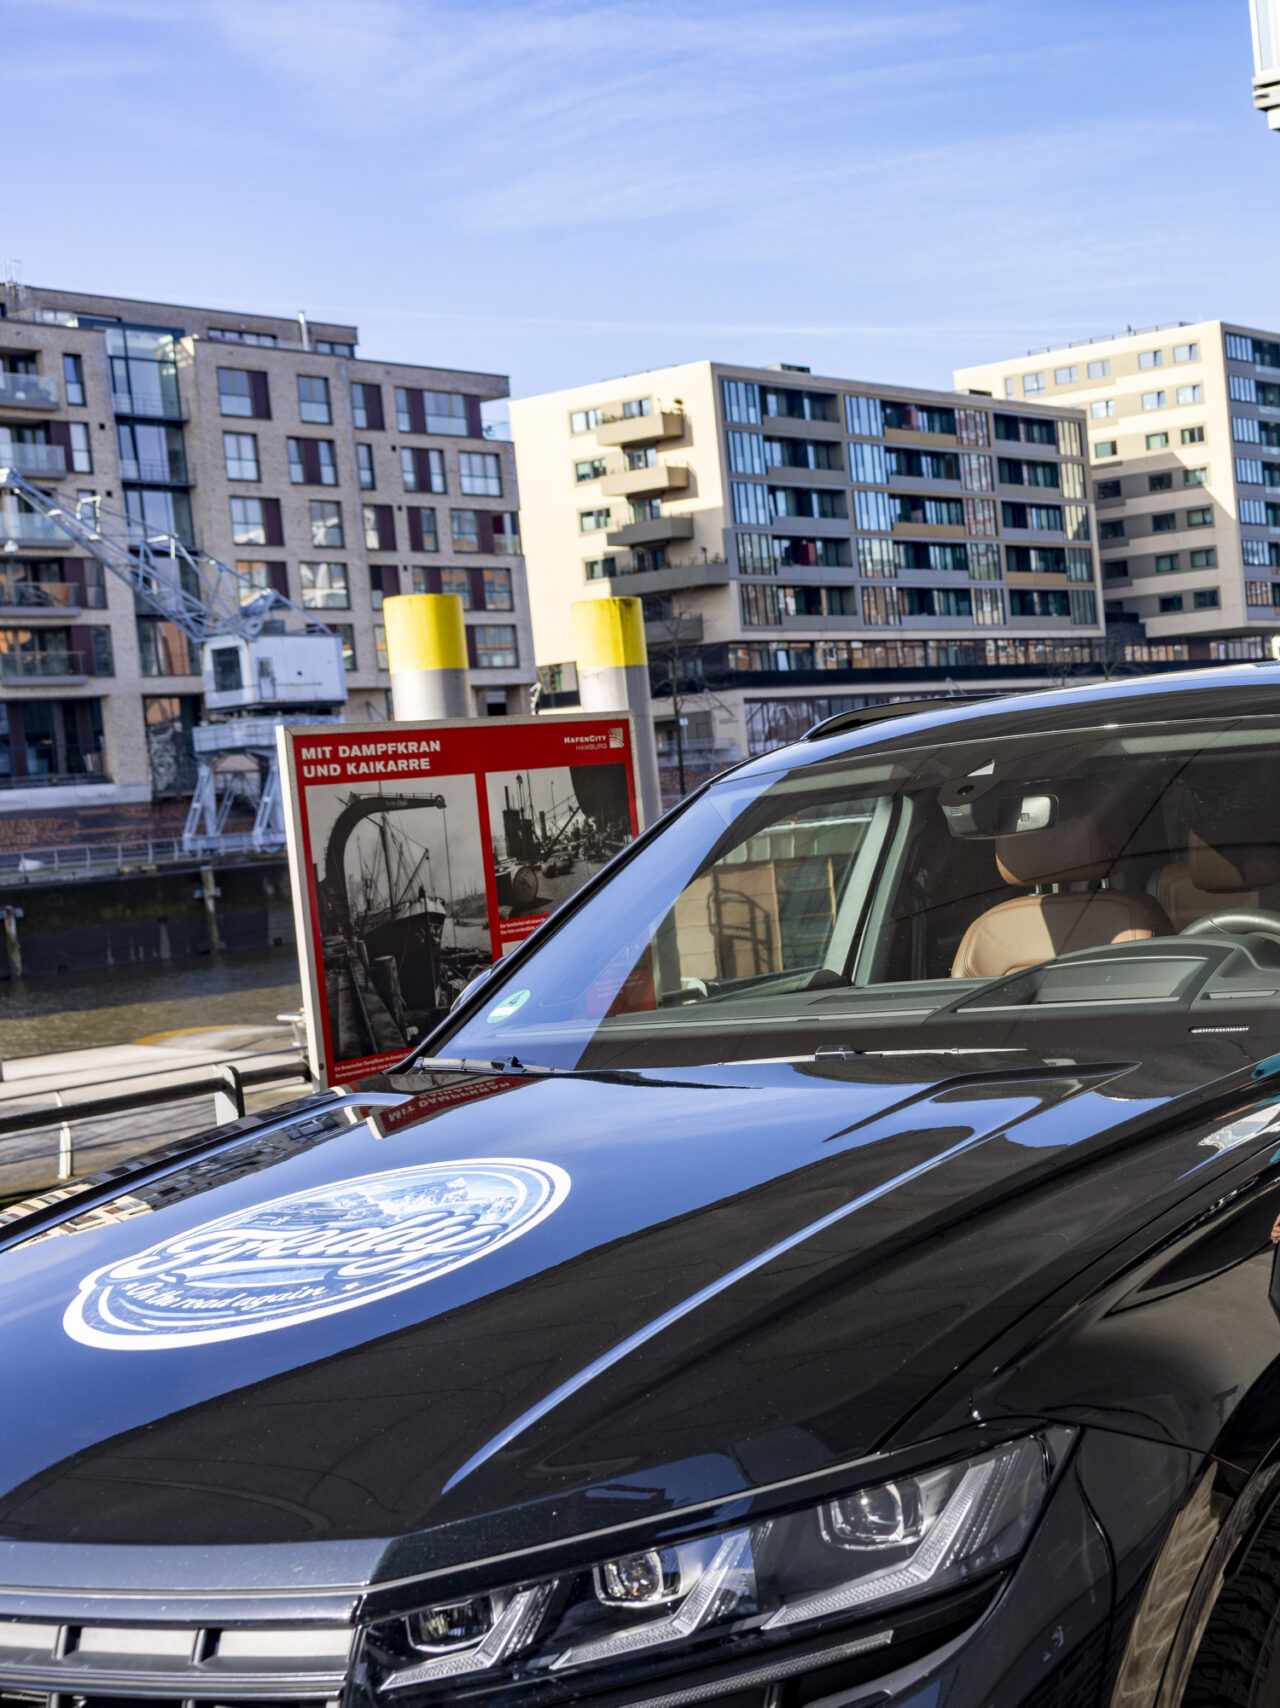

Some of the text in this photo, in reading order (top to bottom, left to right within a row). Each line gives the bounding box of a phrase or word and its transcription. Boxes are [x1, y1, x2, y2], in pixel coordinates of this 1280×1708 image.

[301, 740, 441, 760] MIT DAMPFKRAN
[303, 758, 431, 778] UND KAIKARRE
[126, 1281, 164, 1300] On
[180, 1293, 248, 1310] road
[239, 1286, 329, 1311] again
